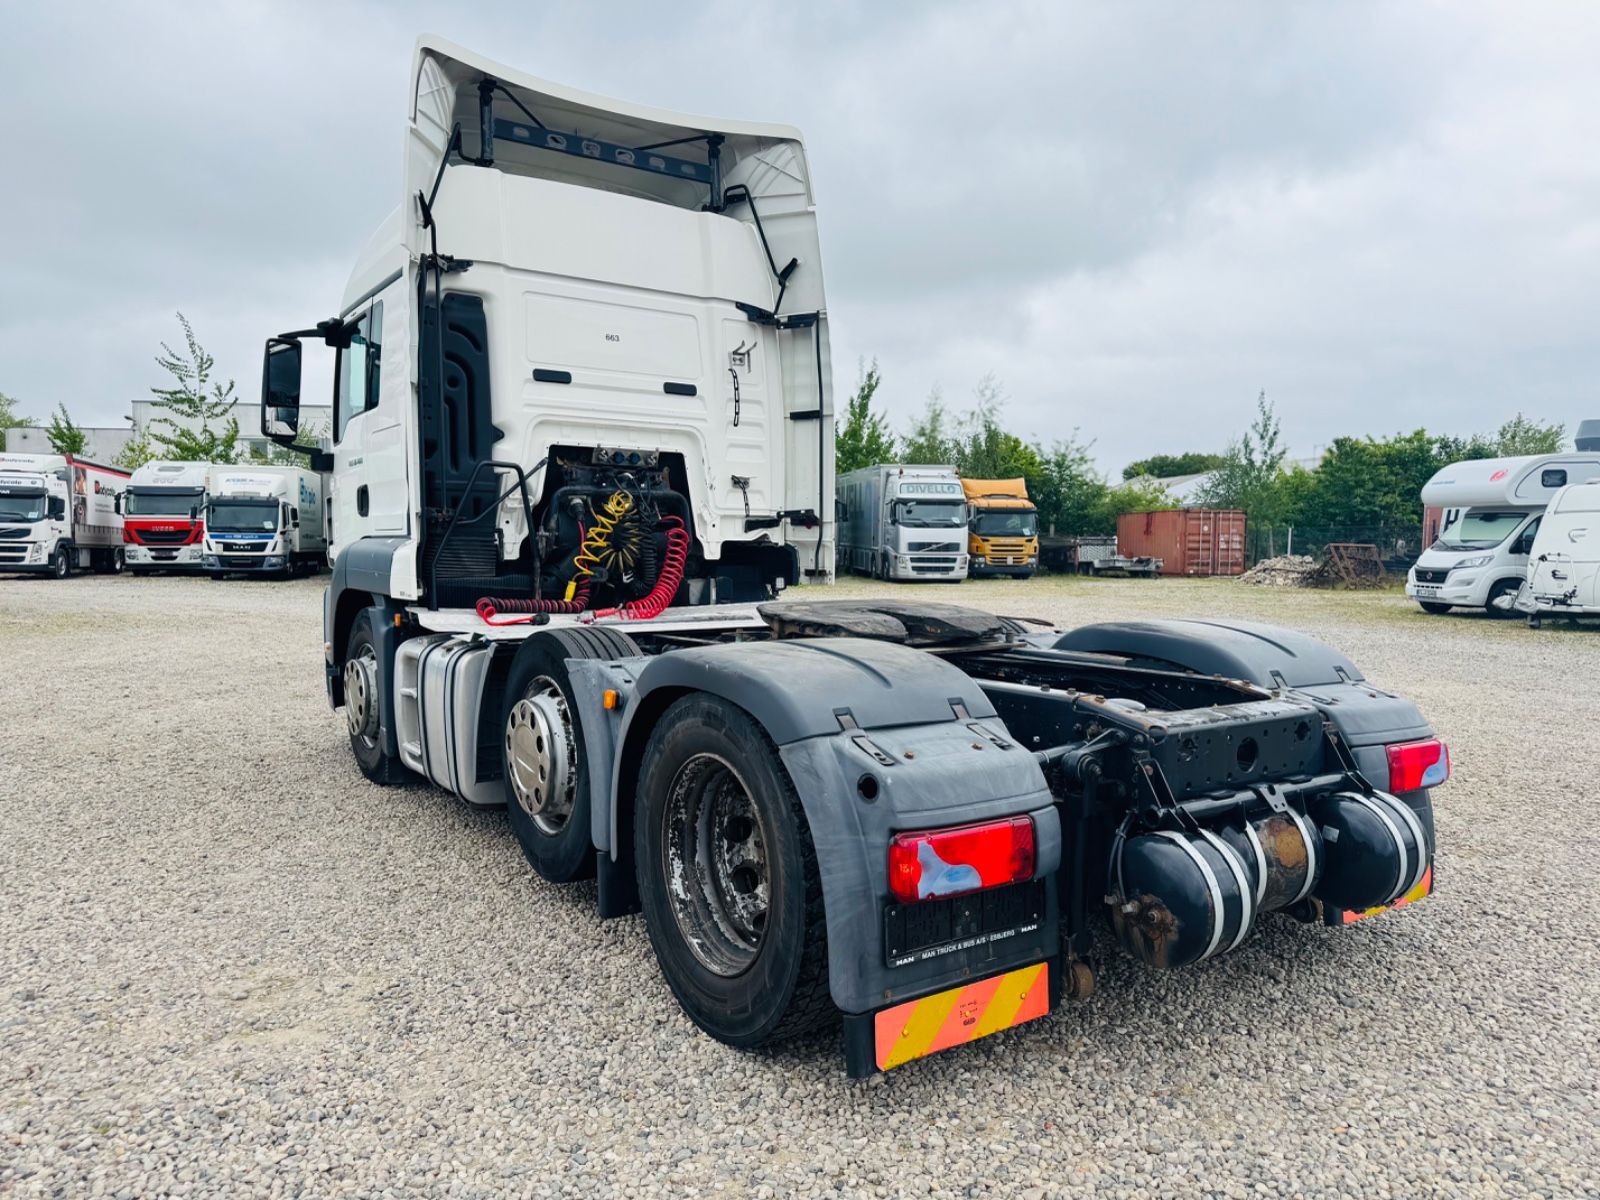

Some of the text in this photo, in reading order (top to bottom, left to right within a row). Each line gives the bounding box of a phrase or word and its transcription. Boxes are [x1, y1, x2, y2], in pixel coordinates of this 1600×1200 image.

[605, 334, 620, 342] 663
[906, 484, 956, 494] DIVELLO
[896, 956, 915, 966] MAN
[922, 950, 936, 959] MAN
[936, 945, 956, 956] TRUCK
[963, 940, 975, 949] BUS
[976, 937, 986, 945] A/S
[990, 929, 1015, 941] ESBJERG
[1021, 924, 1037, 932] MAN
